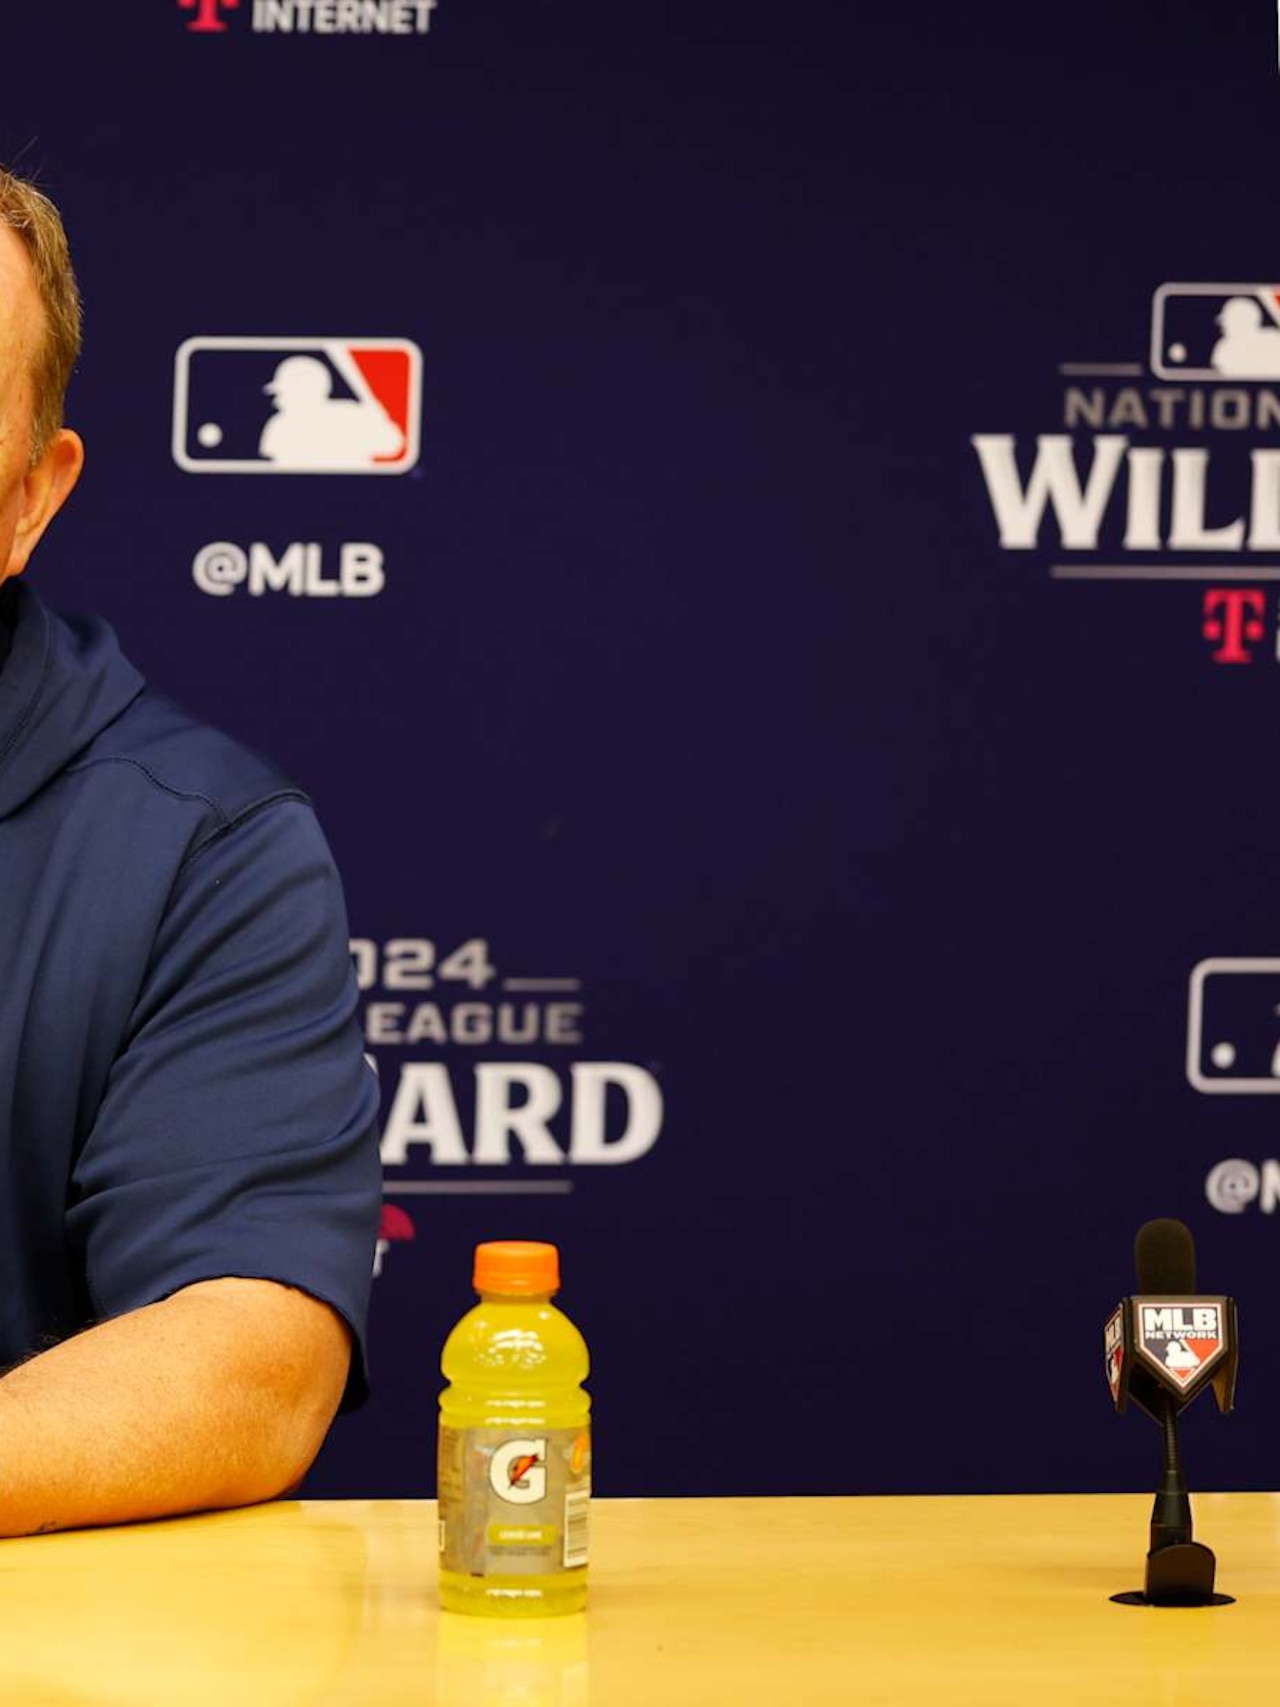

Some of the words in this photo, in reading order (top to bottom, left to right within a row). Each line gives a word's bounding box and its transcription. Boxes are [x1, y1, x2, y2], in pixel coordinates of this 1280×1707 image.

[252, 0, 437, 33] INTERNET
[192, 541, 385, 597] @MLB
[1144, 1308, 1218, 1331] MLB
[1144, 1330, 1218, 1340] NETWORK
[489, 1439, 548, 1504] G
